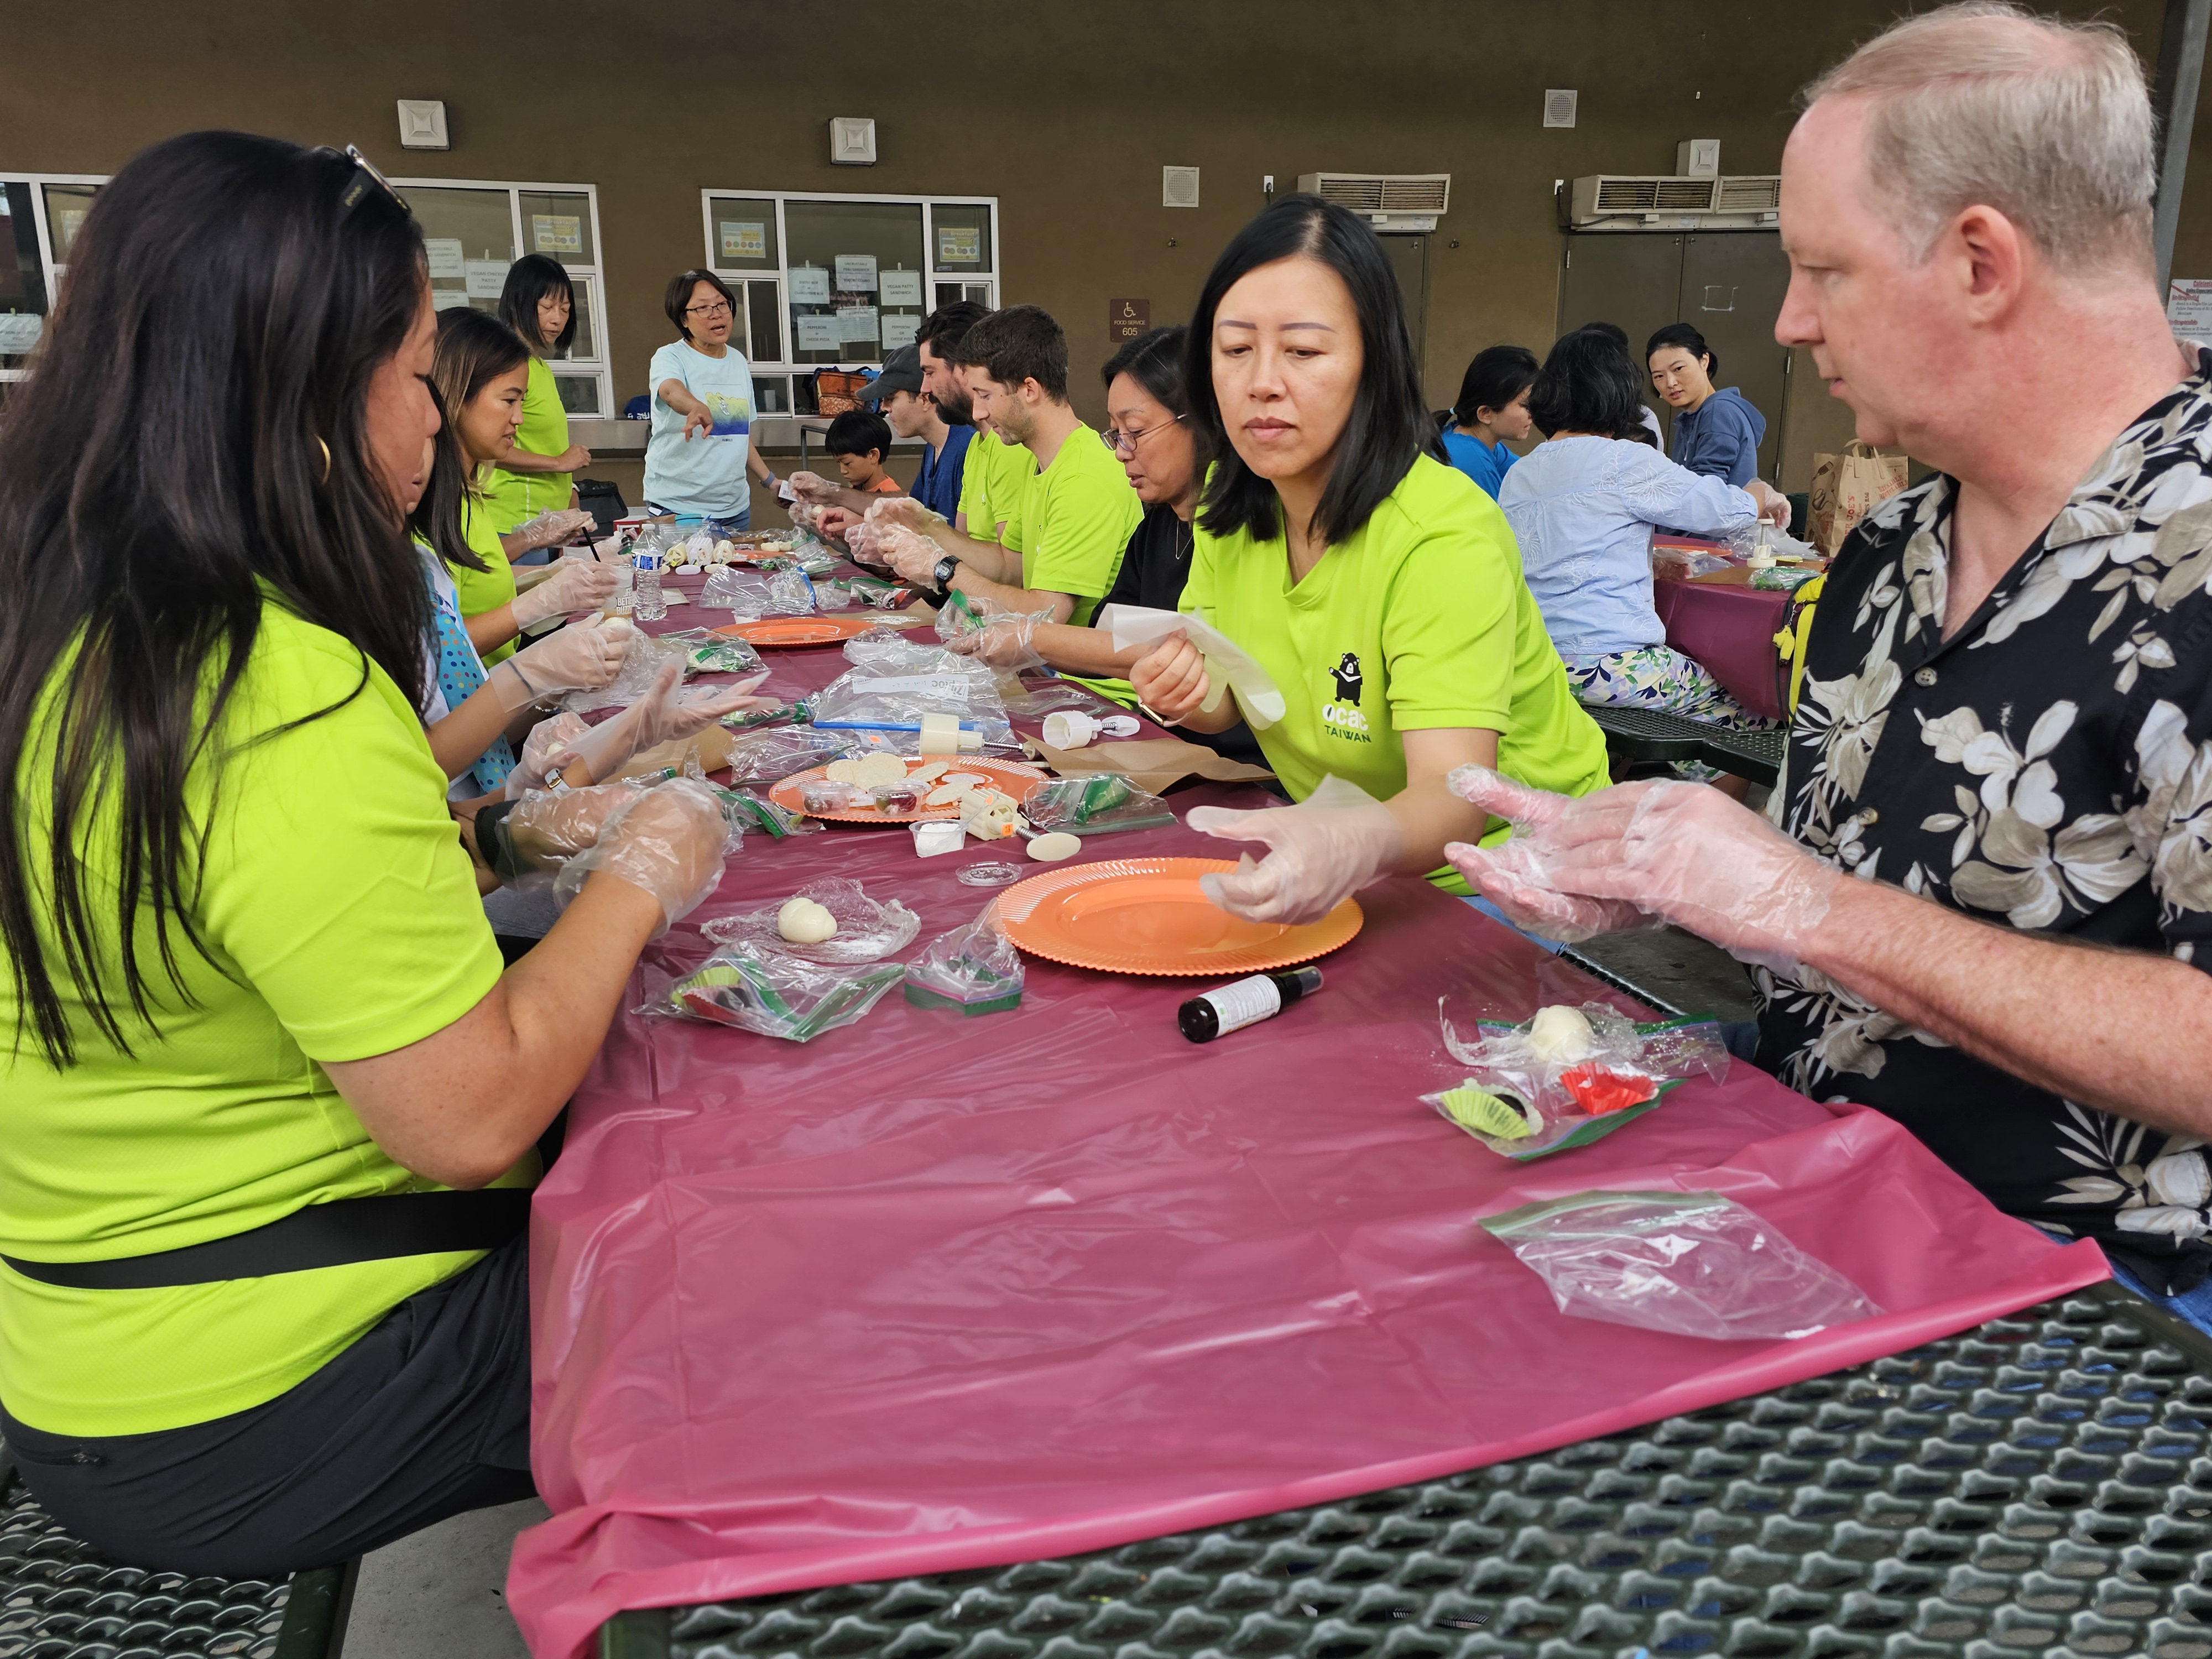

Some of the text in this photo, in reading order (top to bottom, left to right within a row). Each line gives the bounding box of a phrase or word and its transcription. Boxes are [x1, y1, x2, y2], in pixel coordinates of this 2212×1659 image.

[1122, 327, 1138, 336] 605
[1846, 495, 1855, 520] JOE'S
[1324, 724, 1371, 743] TAIWAN
